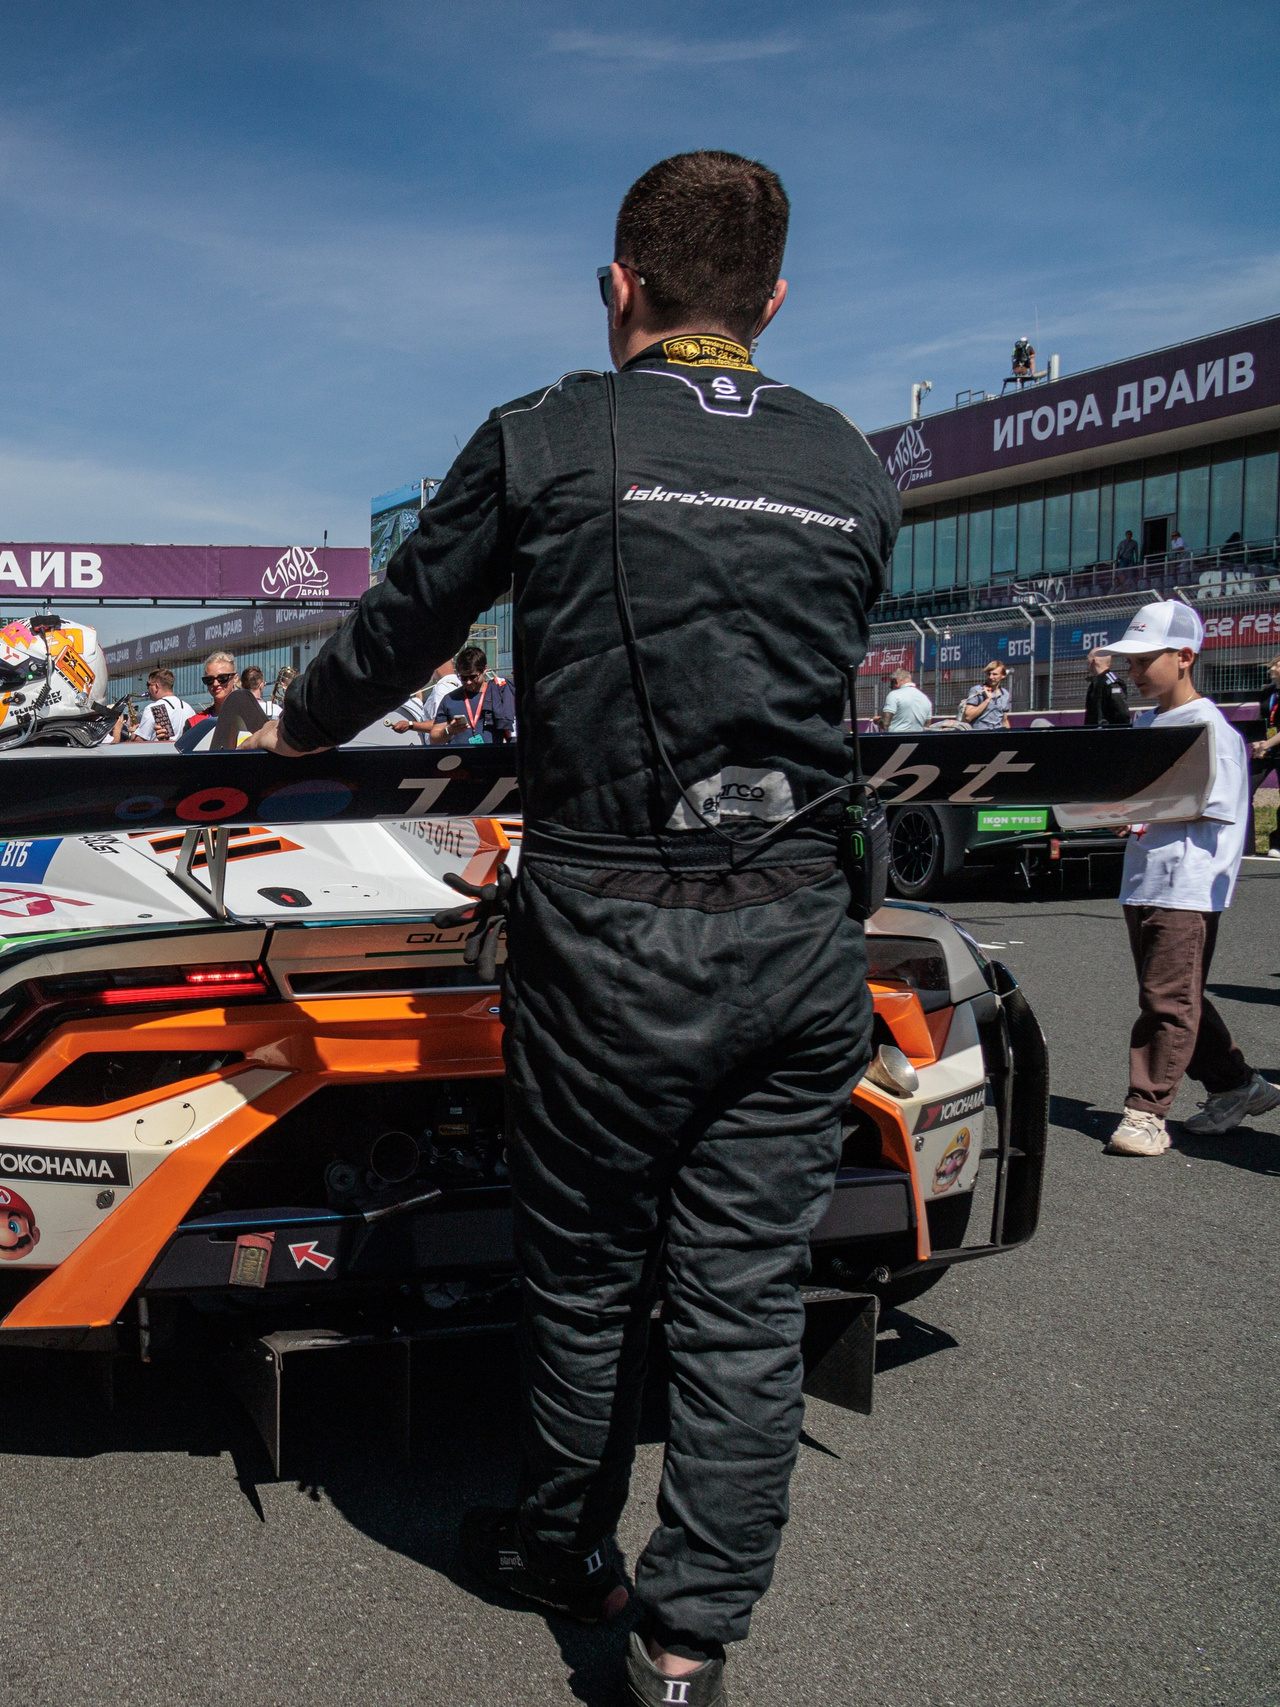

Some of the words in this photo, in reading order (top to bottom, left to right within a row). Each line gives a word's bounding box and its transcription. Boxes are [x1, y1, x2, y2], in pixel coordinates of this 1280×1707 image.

[993, 393, 1103, 452] ИГОРА
[1112, 352, 1255, 428] ДРАЙВ
[622, 485, 698, 505] iskra
[710, 497, 859, 533] motorsport
[1008, 639, 1031, 657] ВТБ
[1083, 631, 1109, 650] ВТБ
[940, 645, 961, 662] ВТБ
[983, 816, 1008, 824] IKON
[1011, 816, 1042, 824] TYRES
[1, 841, 33, 867] ВТБ
[940, 1089, 985, 1121] YOKOHAMA
